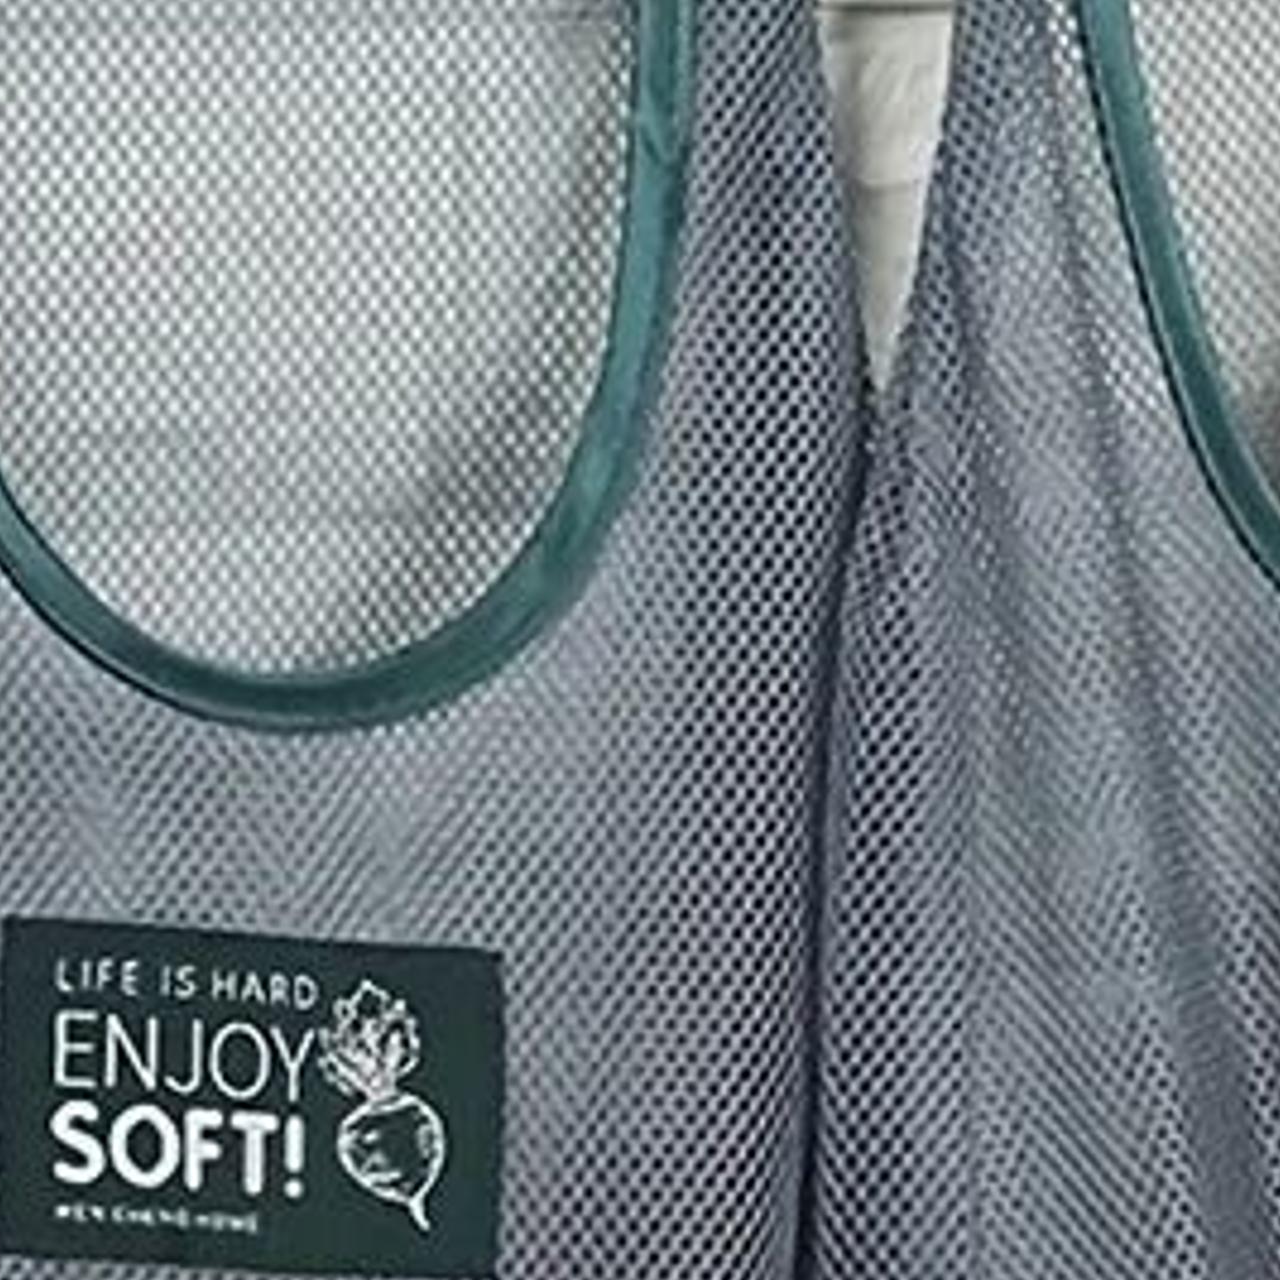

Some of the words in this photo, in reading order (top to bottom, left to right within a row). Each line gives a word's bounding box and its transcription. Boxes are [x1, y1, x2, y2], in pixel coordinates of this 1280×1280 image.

[55, 959, 140, 996] LIFE
[160, 964, 198, 999] IS
[211, 970, 319, 1010] HARD
[53, 1008, 316, 1102] ENJOY
[49, 1099, 306, 1199] SOFT!
